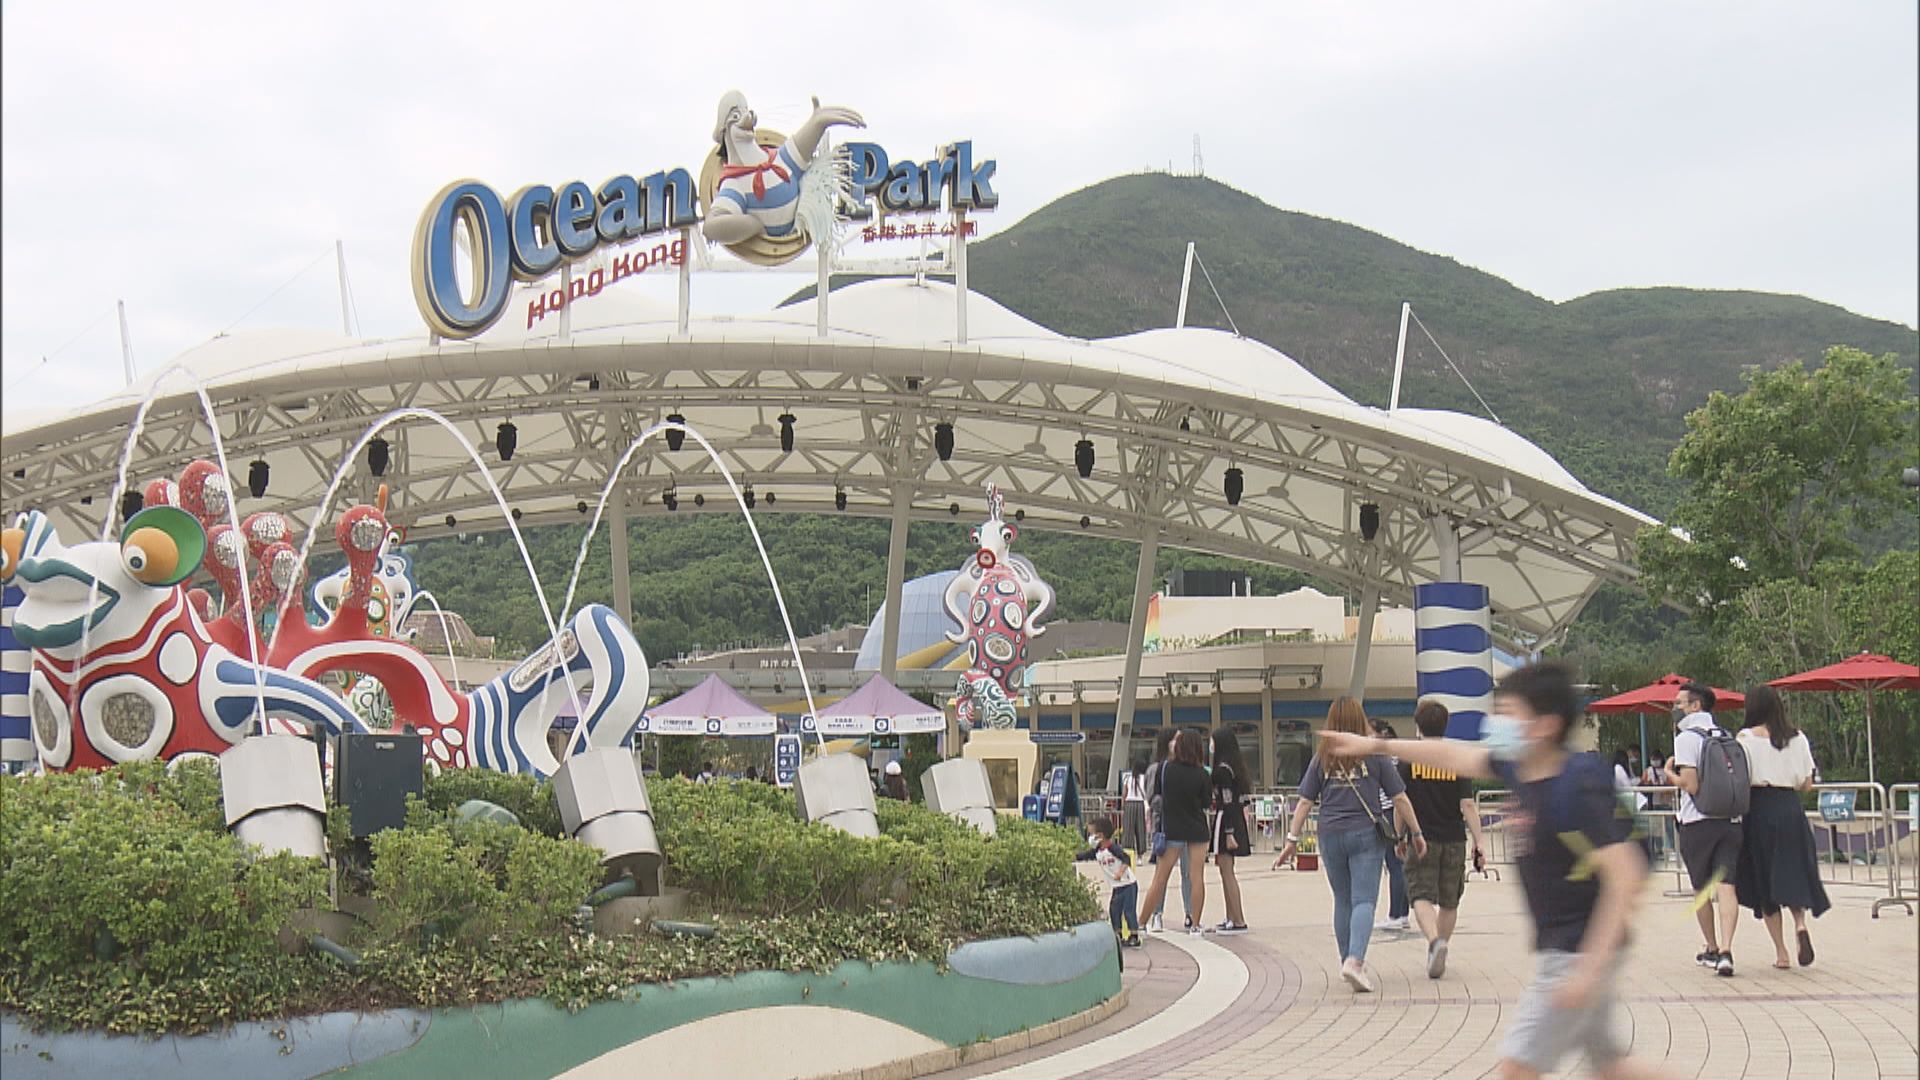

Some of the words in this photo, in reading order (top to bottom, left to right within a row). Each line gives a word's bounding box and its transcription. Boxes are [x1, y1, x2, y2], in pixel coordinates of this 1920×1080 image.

[413, 167, 698, 340] Ocean
[842, 139, 999, 219] Park
[527, 266, 604, 330] Hong
[612, 238, 687, 281] Kong
